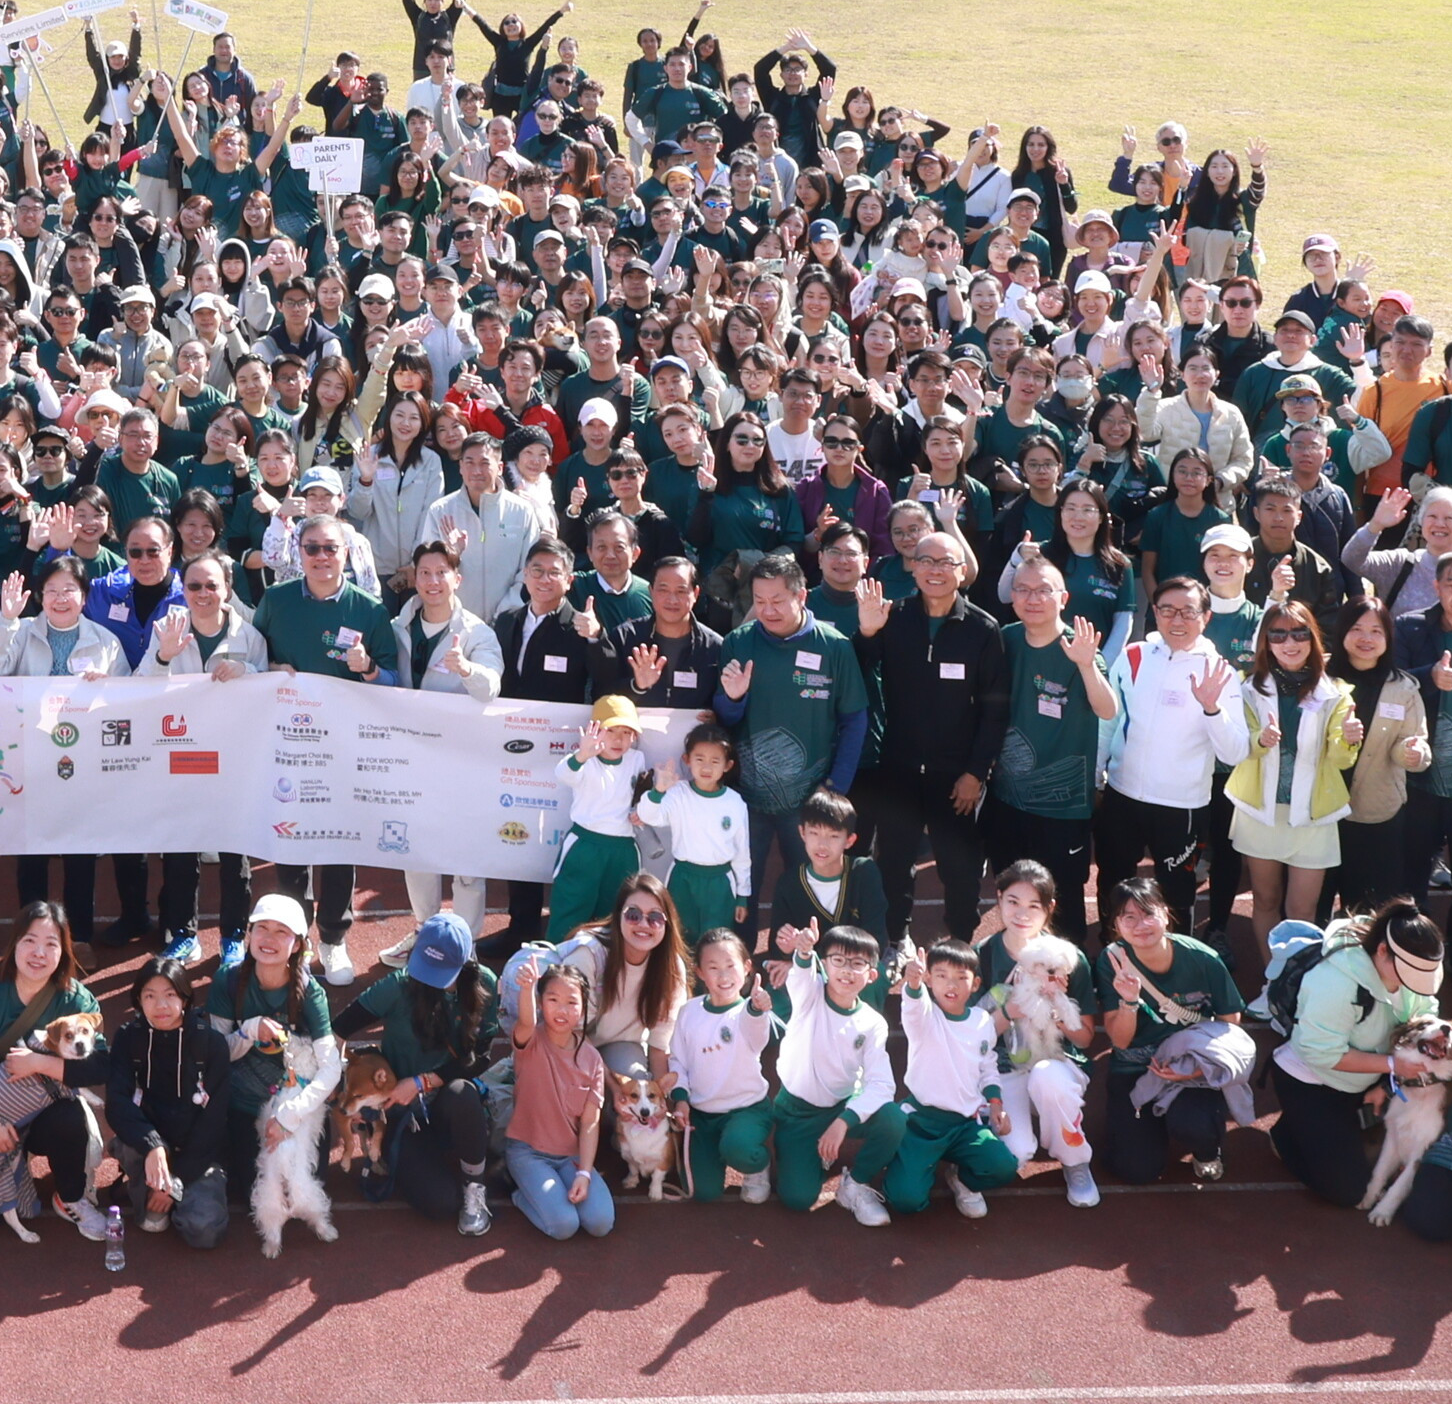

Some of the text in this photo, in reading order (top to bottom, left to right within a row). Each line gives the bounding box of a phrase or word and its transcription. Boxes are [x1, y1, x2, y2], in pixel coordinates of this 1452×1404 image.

[0, 25, 35, 42] Services
[36, 13, 66, 31] Limited
[314, 143, 351, 153] PARENTS
[276, 696, 322, 707] Silver Sponsor
[366, 724, 389, 732] Cheung
[504, 724, 547, 732] Promotional
[500, 777, 557, 789] Gift Sponsorship
